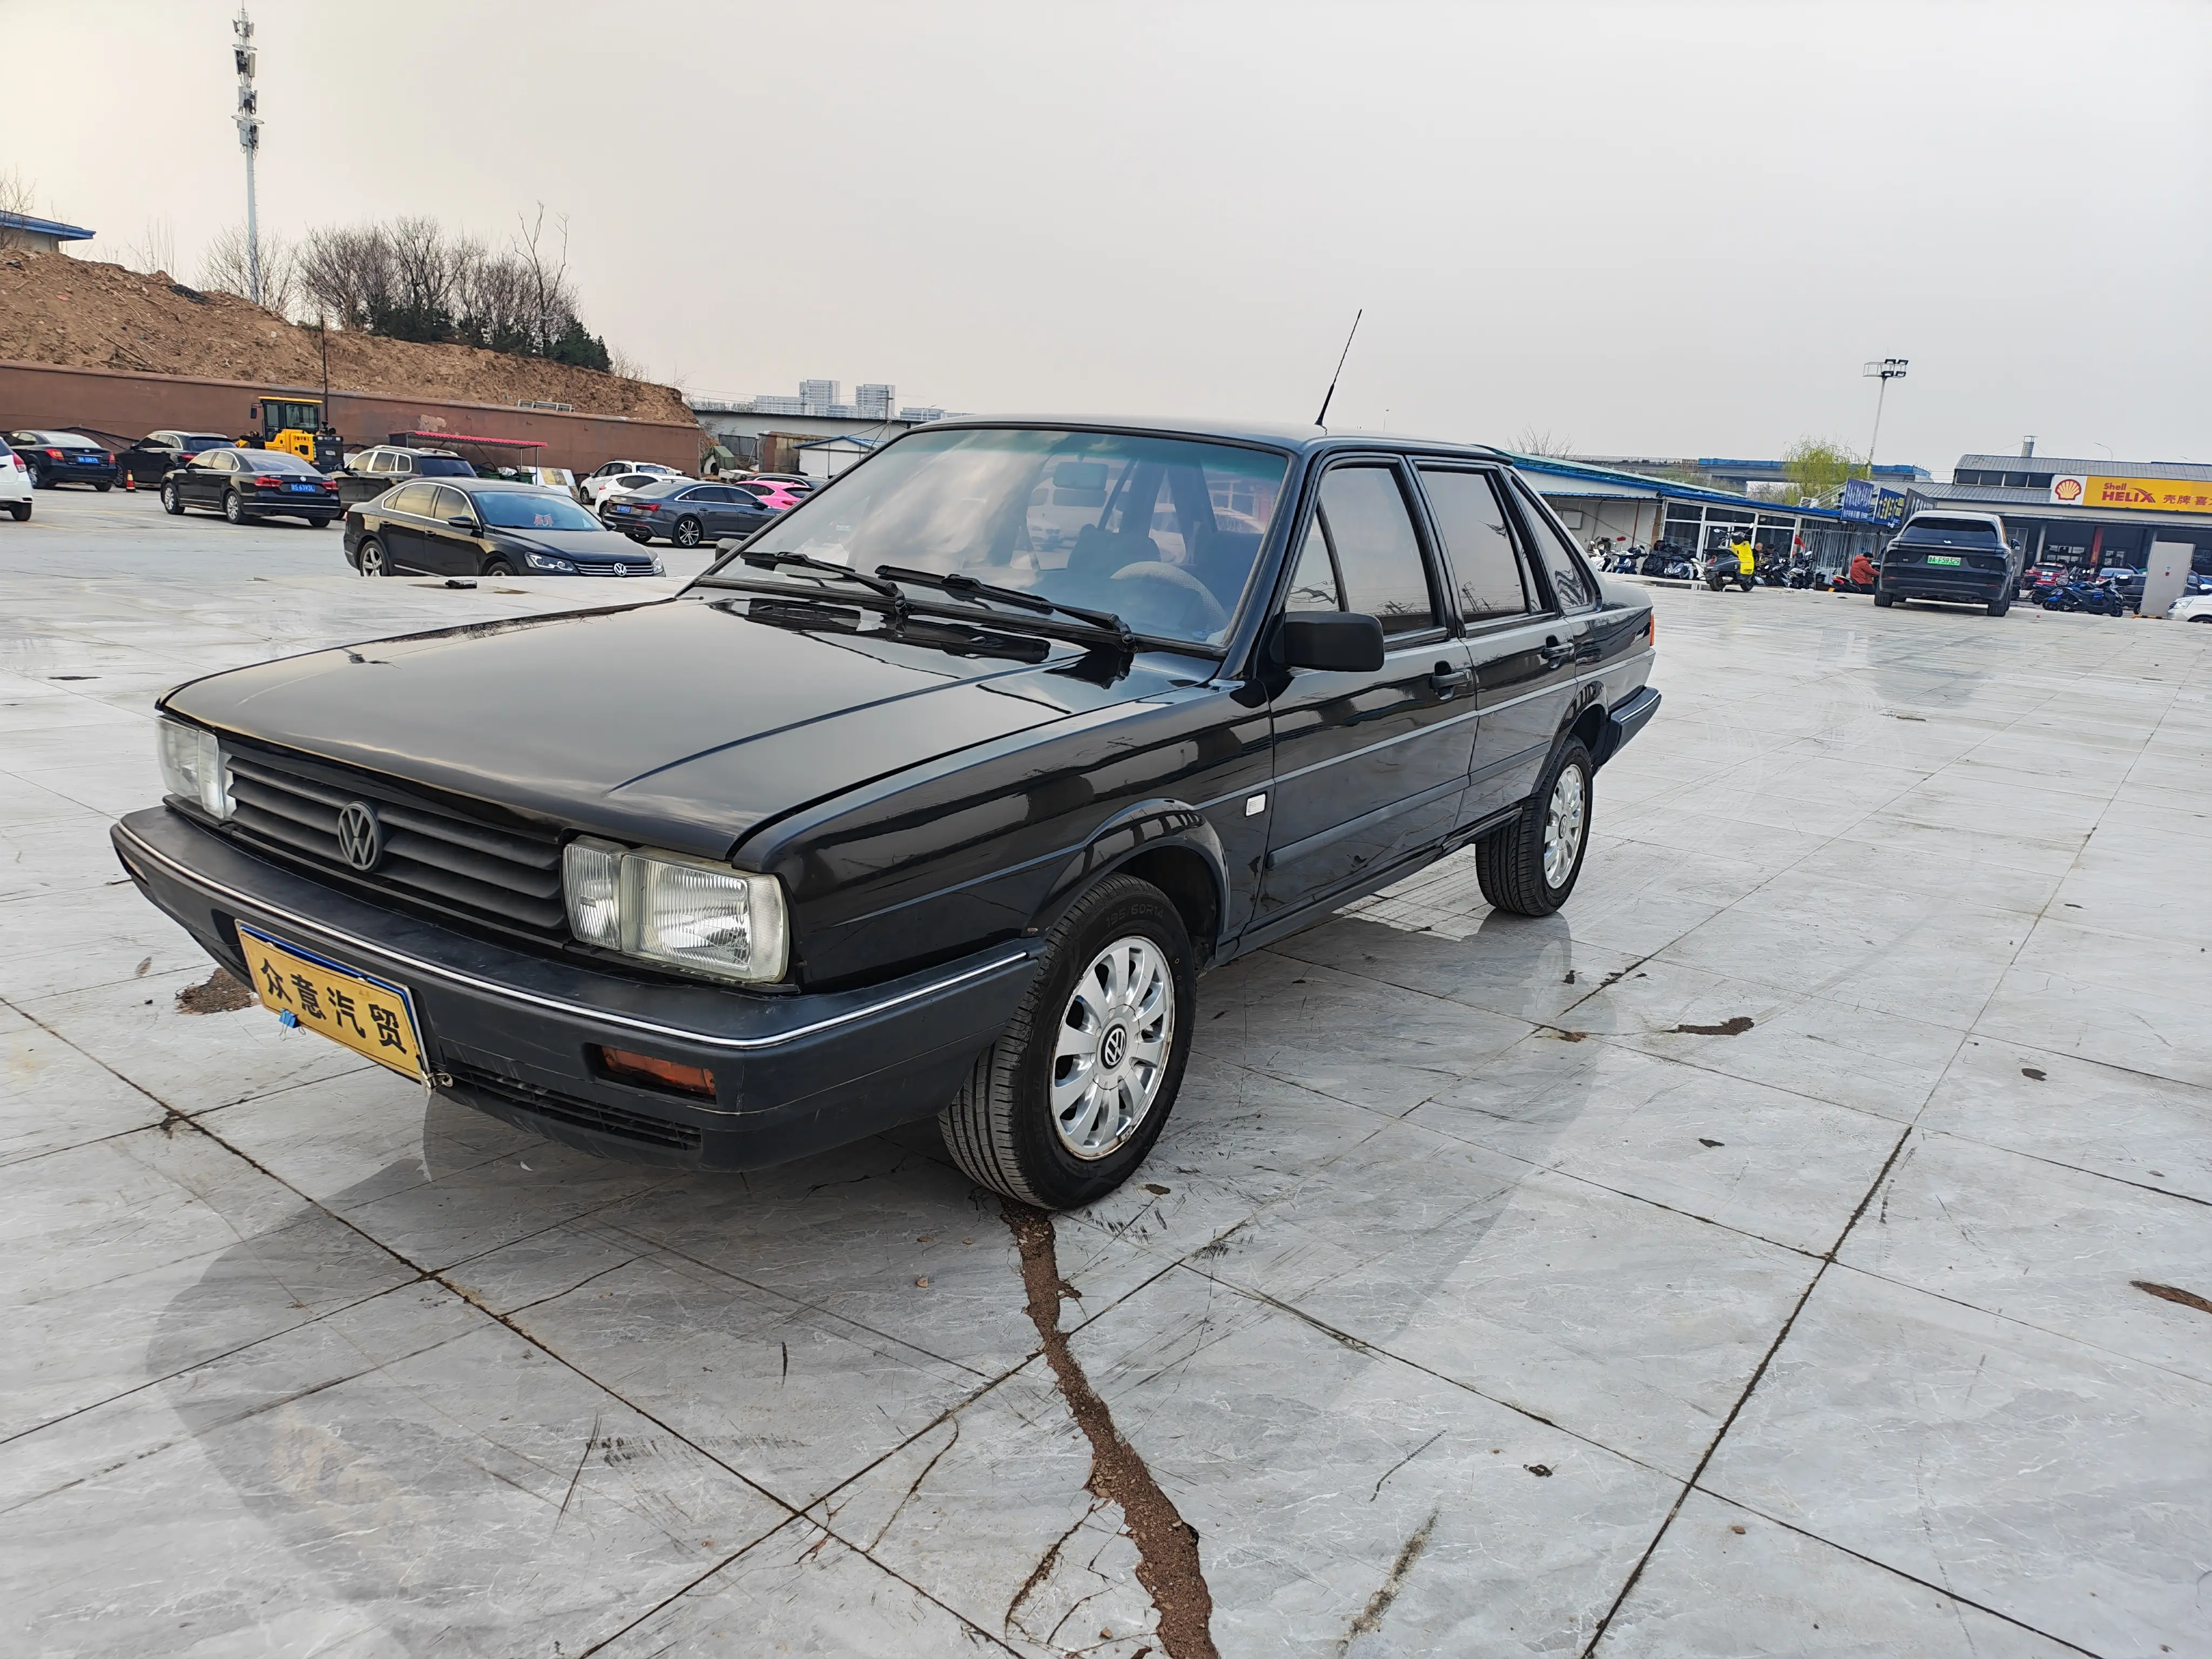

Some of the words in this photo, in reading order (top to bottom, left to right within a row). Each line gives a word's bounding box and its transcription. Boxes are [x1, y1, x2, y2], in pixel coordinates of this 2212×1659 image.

[2102, 488, 2155, 503] HELIX
[1105, 903, 1164, 928] 195/60R14
[260, 958, 408, 1055] 众意汽贸
